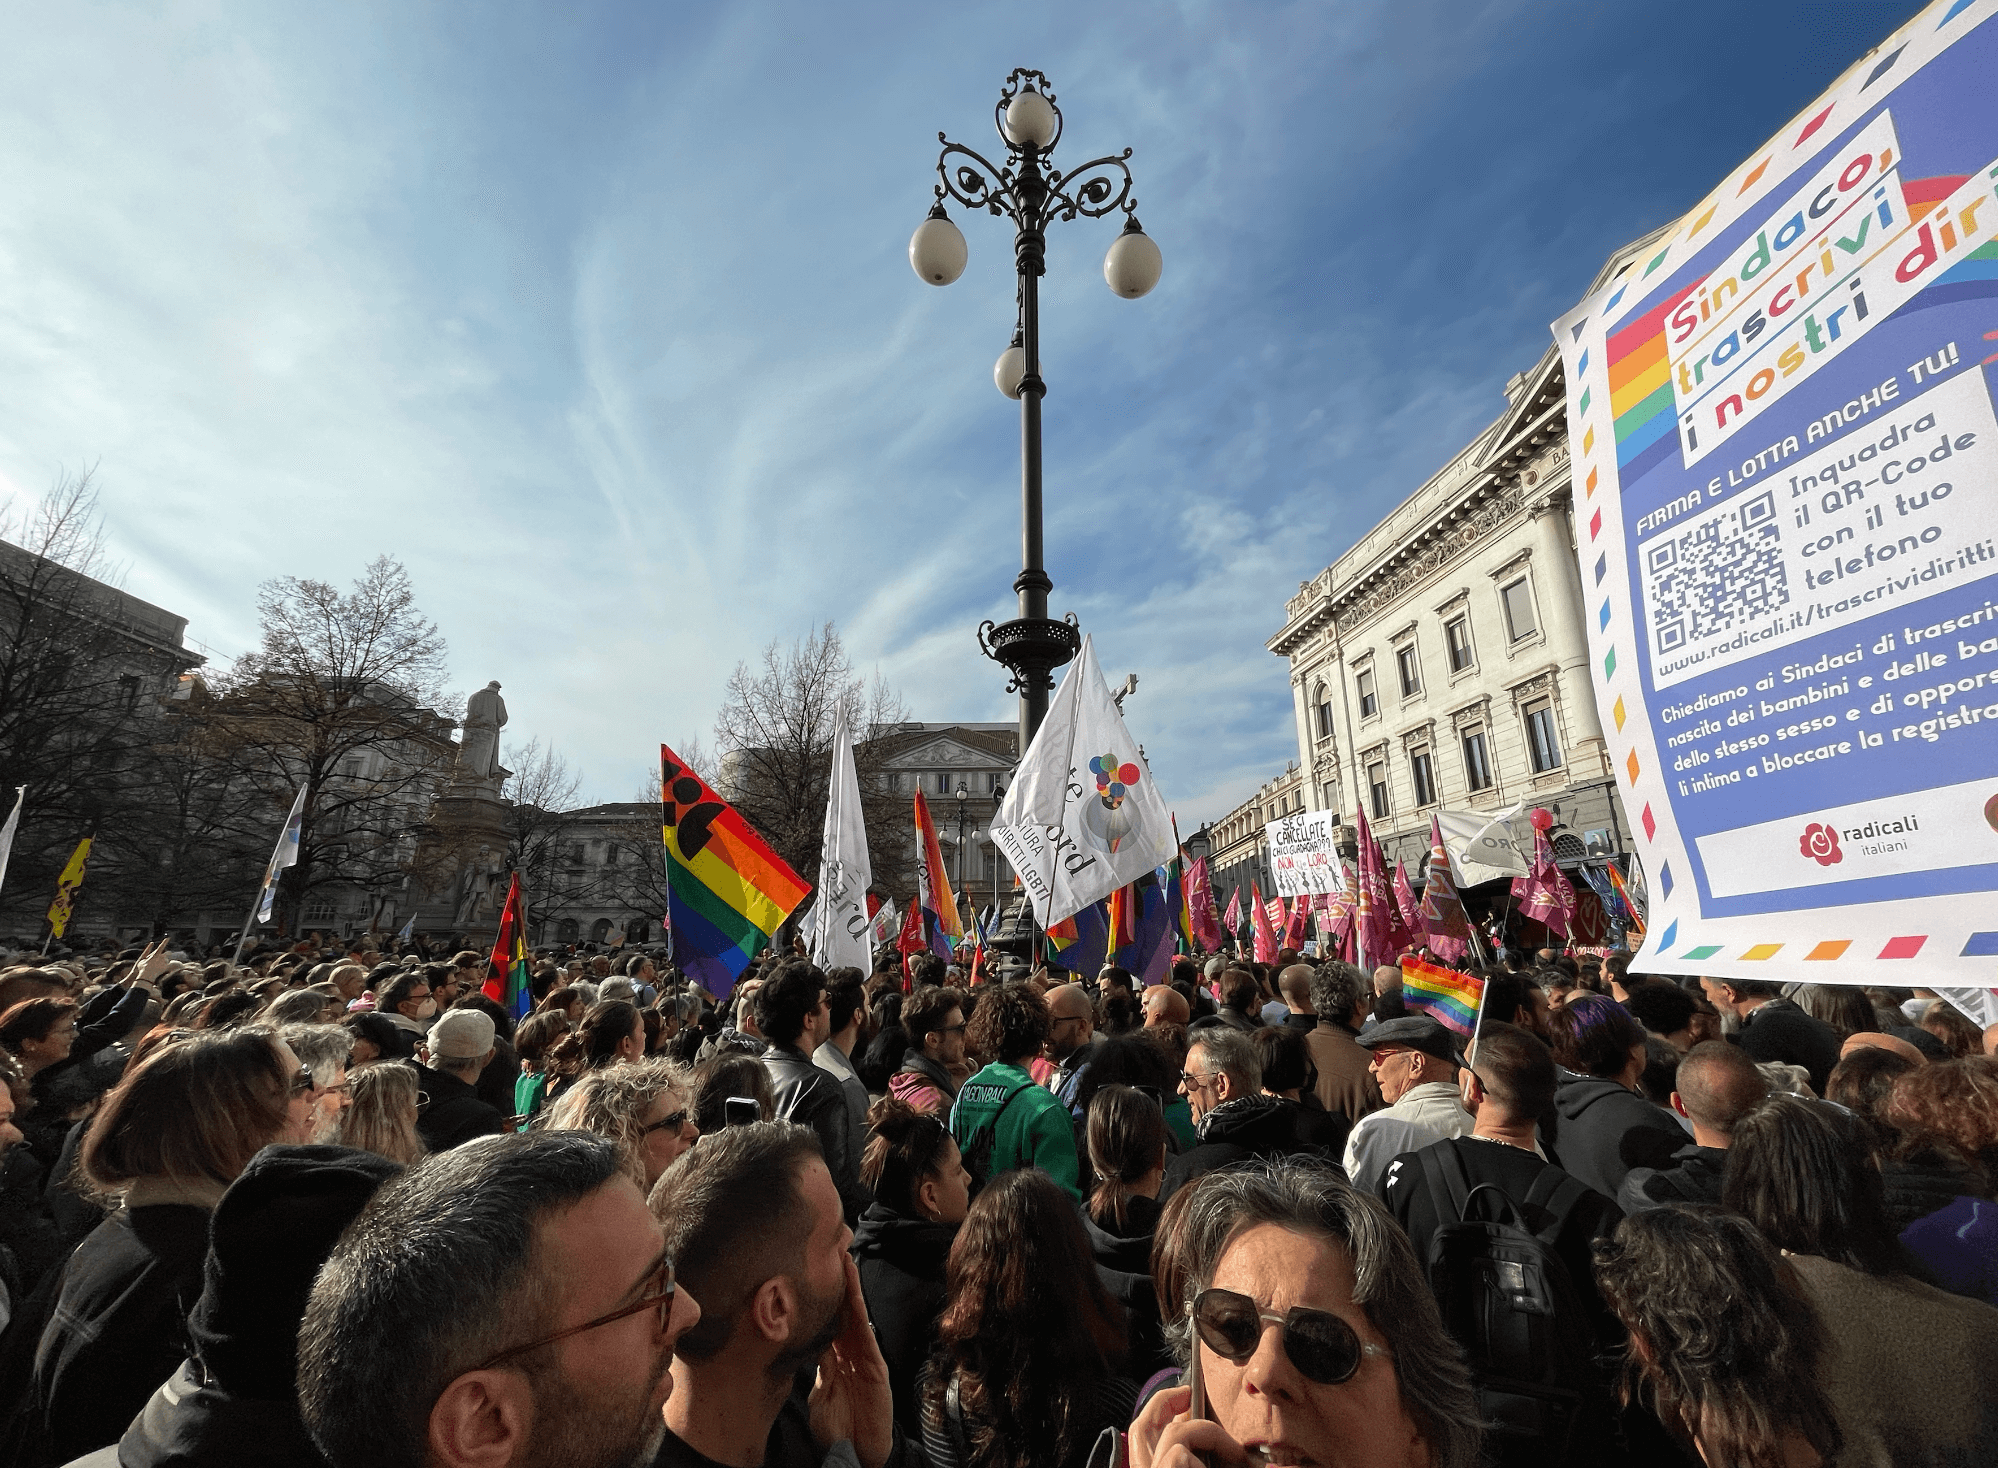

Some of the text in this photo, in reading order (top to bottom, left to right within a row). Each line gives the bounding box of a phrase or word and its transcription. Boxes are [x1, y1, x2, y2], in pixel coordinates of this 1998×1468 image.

[1671, 147, 1893, 343] Sindaco,
[1678, 185, 1894, 396] trascrivi
[1685, 413, 1699, 453] i
[1714, 277, 1869, 430] nostri
[1636, 341, 1960, 537] FIRMA E LOTTA ANCHE TU!
[1789, 412, 1936, 499] Inquadra
[1794, 432, 1978, 529] il QR-Code
[1801, 482, 1953, 558] con il tuo
[1805, 526, 1942, 590] telefono
[1661, 685, 1749, 724] Chiediamo
[1755, 671, 1775, 692] ai
[1781, 643, 1864, 684] Sindaci
[1872, 632, 1896, 656] di
[1667, 719, 1722, 749] nascita
[1726, 704, 1755, 727] dei
[1760, 675, 1850, 718] bambini
[1858, 675, 1873, 689] e
[1883, 652, 1948, 681] delle
[1673, 749, 1710, 772] dello
[1714, 733, 1770, 759] stesso
[1776, 714, 1837, 741] sesso
[1845, 708, 1861, 721] e
[1870, 692, 1894, 715] di
[1678, 780, 1690, 797] li
[1691, 771, 1741, 794] intima
[1745, 765, 1759, 778] a
[1761, 741, 1852, 774] bloccare
[1858, 730, 1884, 750] la
[1276, 820, 1326, 846] CANCELLATE
[1281, 815, 1305, 831] SE CI
[1306, 852, 1328, 867] LORO
[1842, 815, 1919, 841] radicali
[1861, 839, 1908, 856] italiani
[1277, 855, 1295, 870] NON
